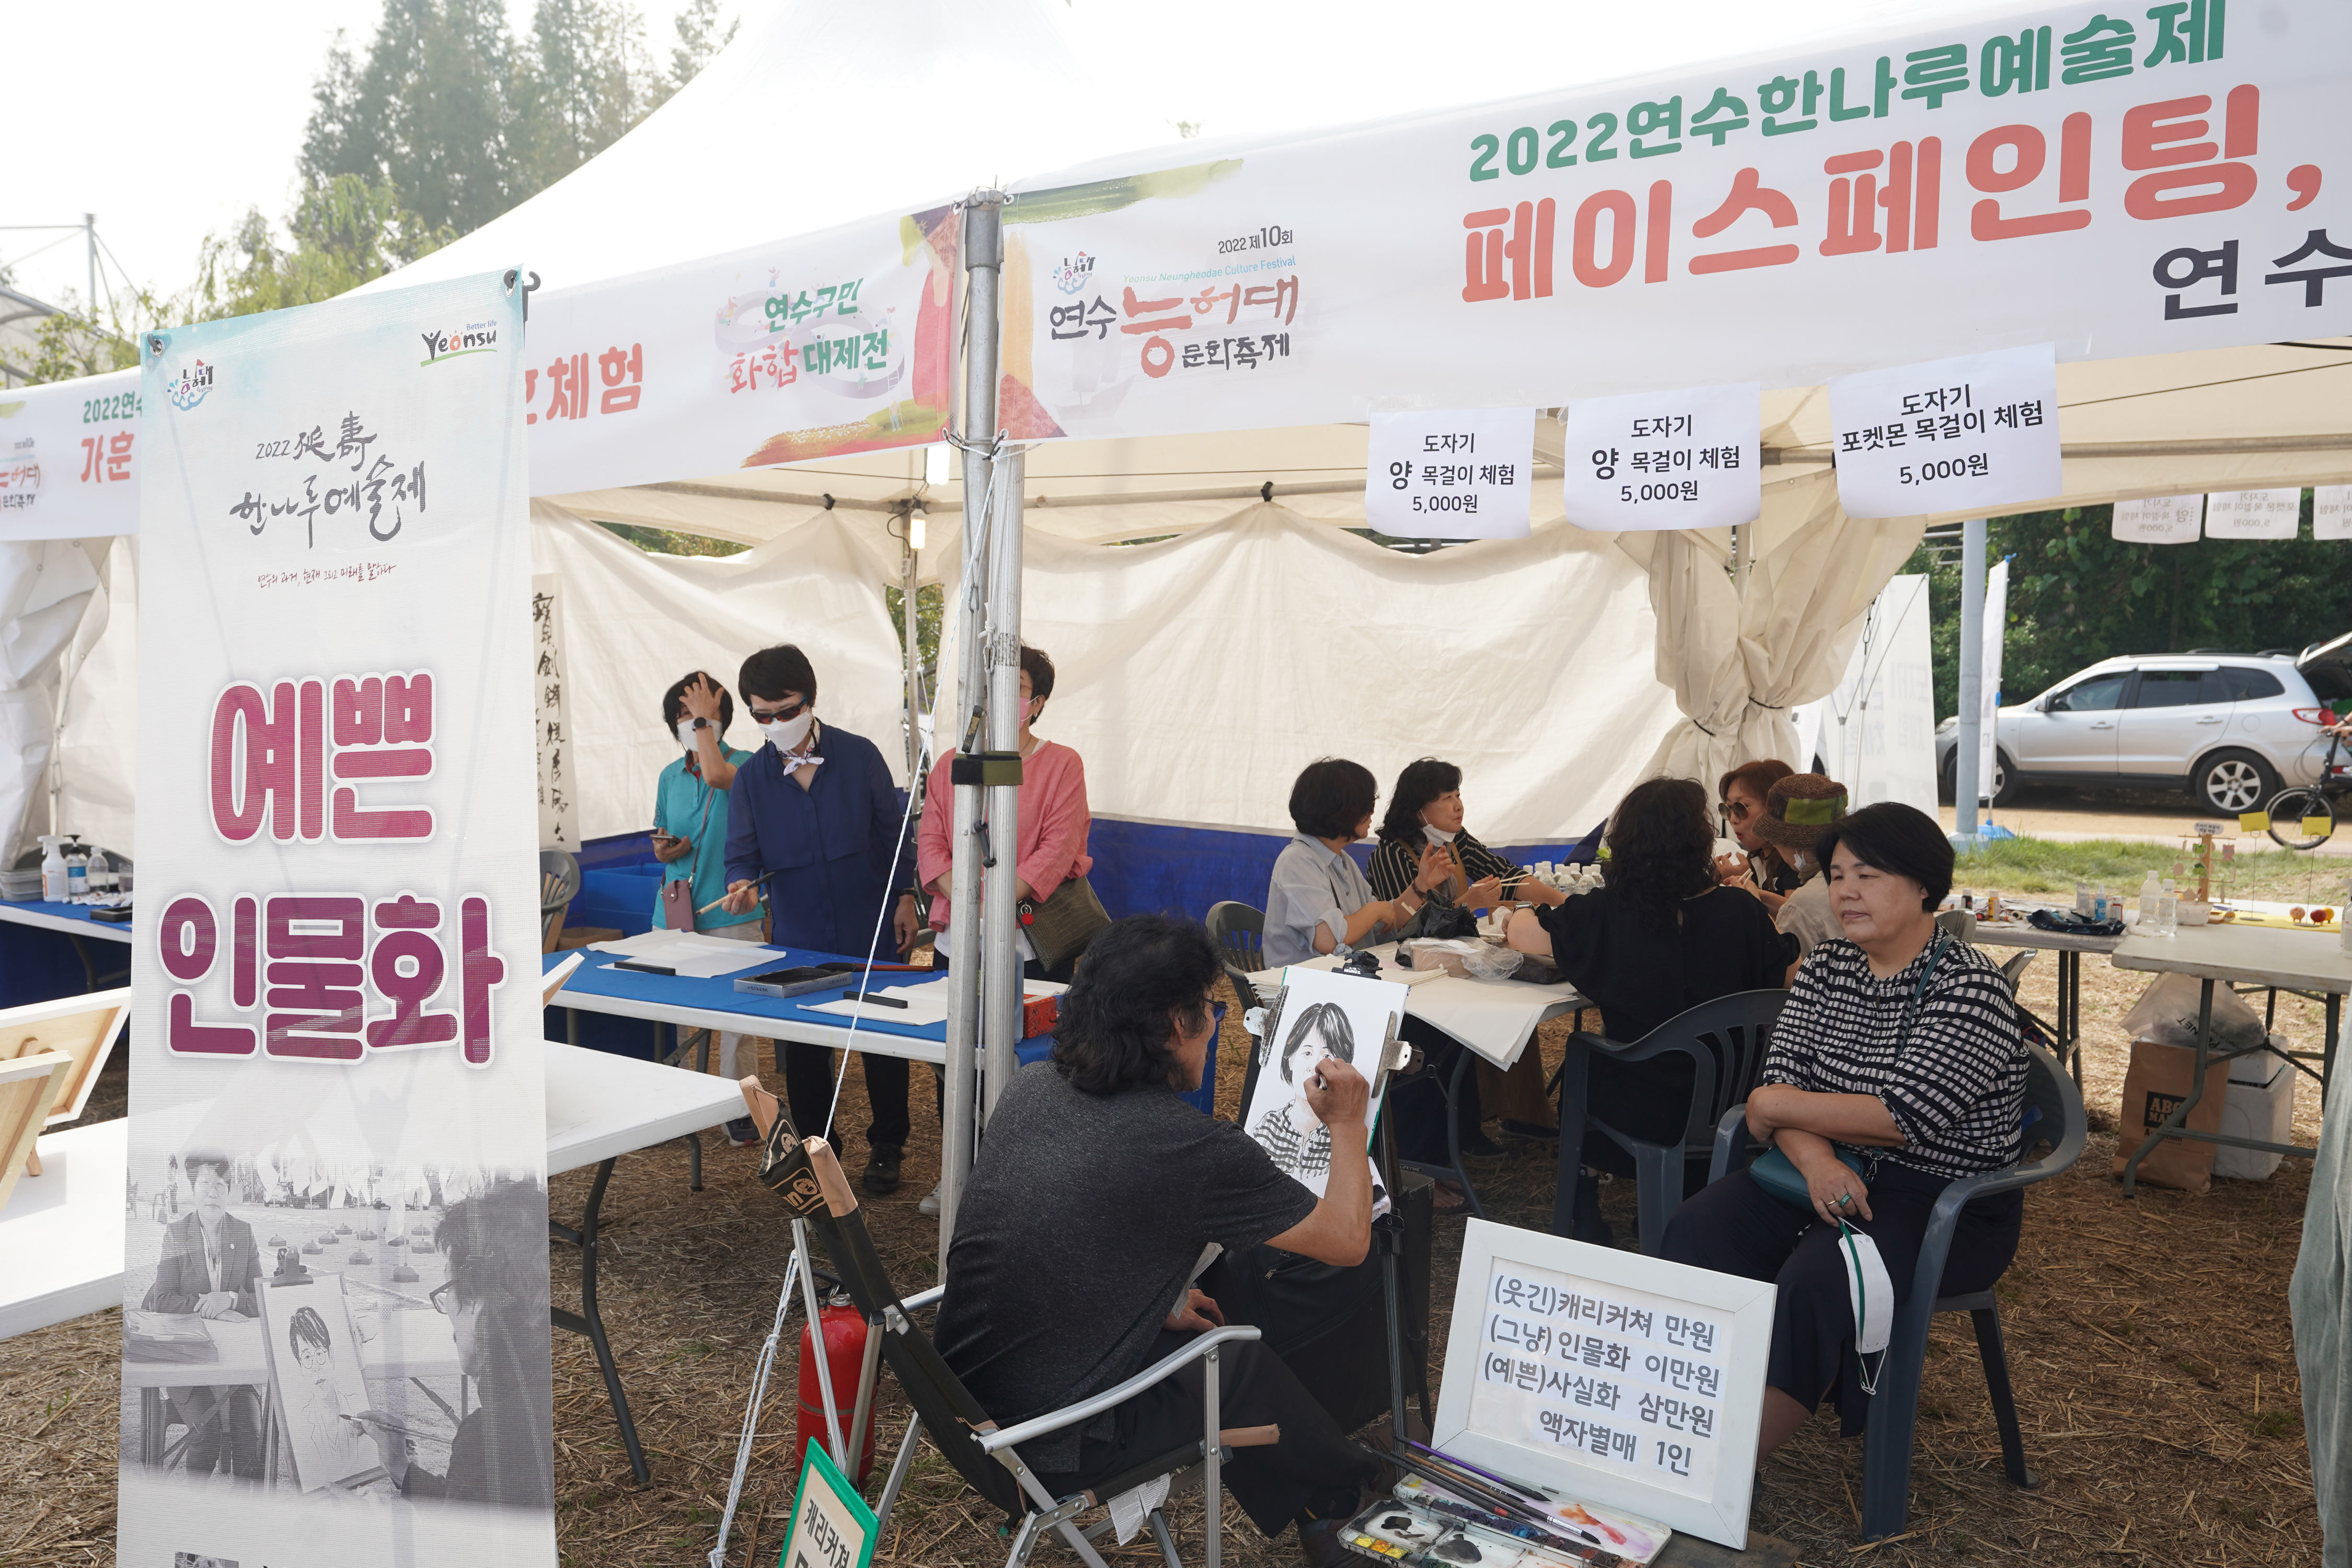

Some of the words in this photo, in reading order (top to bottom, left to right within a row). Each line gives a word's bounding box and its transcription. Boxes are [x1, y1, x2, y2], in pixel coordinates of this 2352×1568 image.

[1469, 0, 2226, 183] 2022연수한나루예술제
[1462, 83, 2323, 304] 페이스페인팅,
[1218, 237, 1247, 254] 2022
[1249, 225, 1293, 249] 제10회
[1123, 273, 1157, 283] Yeonsu
[1159, 268, 1223, 282] Neungheodae
[1225, 263, 1259, 276] Culture
[1261, 256, 1296, 271] Festival
[764, 278, 864, 332] 연수구민
[1050, 295, 1117, 340] 연수
[422, 329, 497, 361] Yeonsu
[467, 322, 487, 331] Better
[1120, 275, 1299, 378] 능허대
[730, 340, 799, 395] 화합
[803, 329, 887, 375] 대제전
[1182, 332, 1290, 371] 문화축제
[1901, 384, 1971, 416] 도자기
[1422, 433, 1476, 455] 도자기
[1630, 414, 1693, 439] 도자기
[1842, 422, 1908, 453] 포켓몬
[1914, 409, 1986, 442] 목걸이
[1993, 400, 2043, 429] 체험
[80, 430, 134, 483] 가훈
[256, 440, 291, 459] 2022
[1591, 448, 1619, 481] 양
[1629, 447, 1693, 473] 목걸이
[1698, 445, 1742, 470] 체험
[1899, 453, 1989, 486] 5,000원
[1389, 460, 1413, 491] 양
[1421, 462, 1474, 487] 목걸이
[1479, 464, 1515, 486] 체험
[1620, 480, 1699, 504] 5,000원
[229, 454, 425, 549] 한나루예술제
[1412, 493, 1479, 515] 5,000원
[258, 573, 278, 588] 연수의
[303, 569, 320, 584] 현재
[324, 570, 338, 580] 그리고
[341, 563, 365, 582] 미래를
[210, 672, 433, 841] 예쁜
[160, 894, 504, 1064] 인물화
[1494, 1274, 1653, 1339] (웃긴)캐리커쳐
[1664, 1314, 1714, 1354] 만원
[1490, 1313, 1552, 1356] (그냥)
[1558, 1331, 1630, 1372] 인물화
[1644, 1355, 1720, 1398] 이만원
[1484, 1352, 1621, 1411] (예쁜)사실화
[1637, 1392, 1714, 1439] 삼만원
[1539, 1410, 1637, 1462] 액자별매
[1655, 1441, 1692, 1477] 1인
